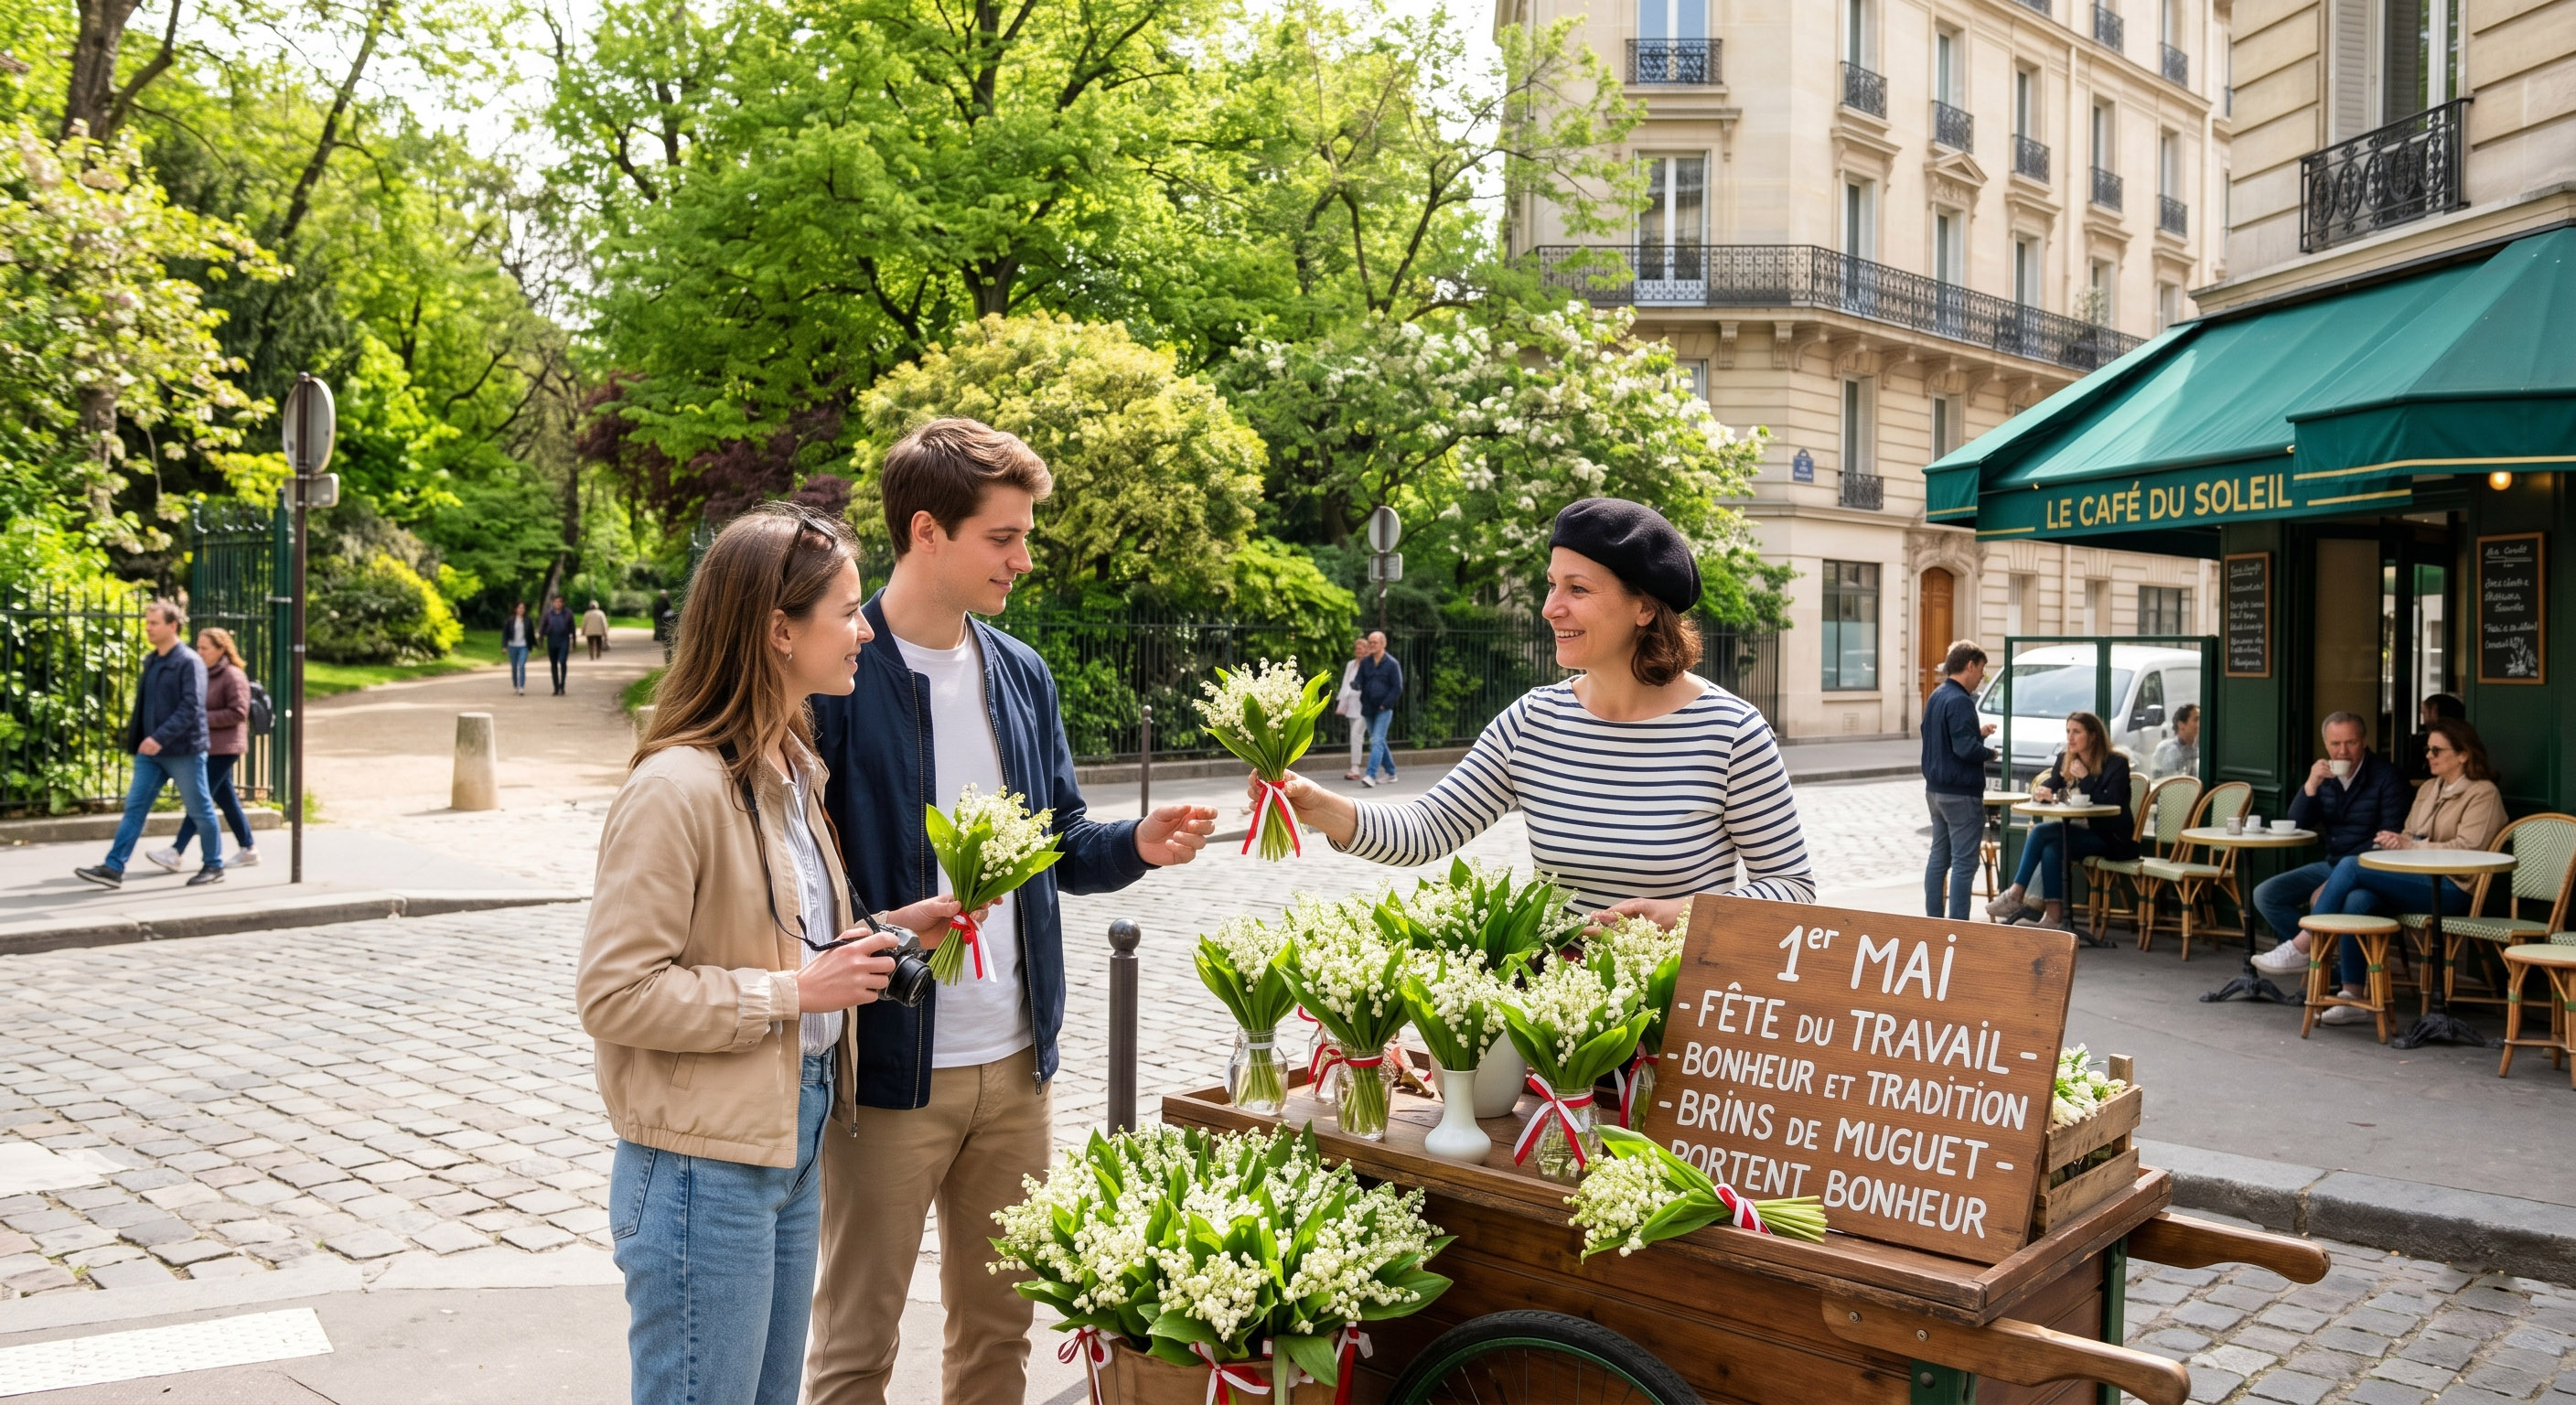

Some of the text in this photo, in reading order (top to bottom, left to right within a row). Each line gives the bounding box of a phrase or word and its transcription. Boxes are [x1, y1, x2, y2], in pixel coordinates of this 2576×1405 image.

[2046, 473, 2292, 529] LE CAFÉ DU SOLEIL
[1776, 925, 1840, 982] 1er
[1698, 981, 1787, 1040] FÊTE
[1795, 1014, 1835, 1046] DU
[1681, 1041, 1815, 1095] BONHEUR
[1823, 1073, 1856, 1101] ET
[1785, 1117, 1822, 1151] DE
[1833, 1117, 1990, 1180] MUGUET
[1670, 1139, 1987, 1239] PORTENT BONHEUR
